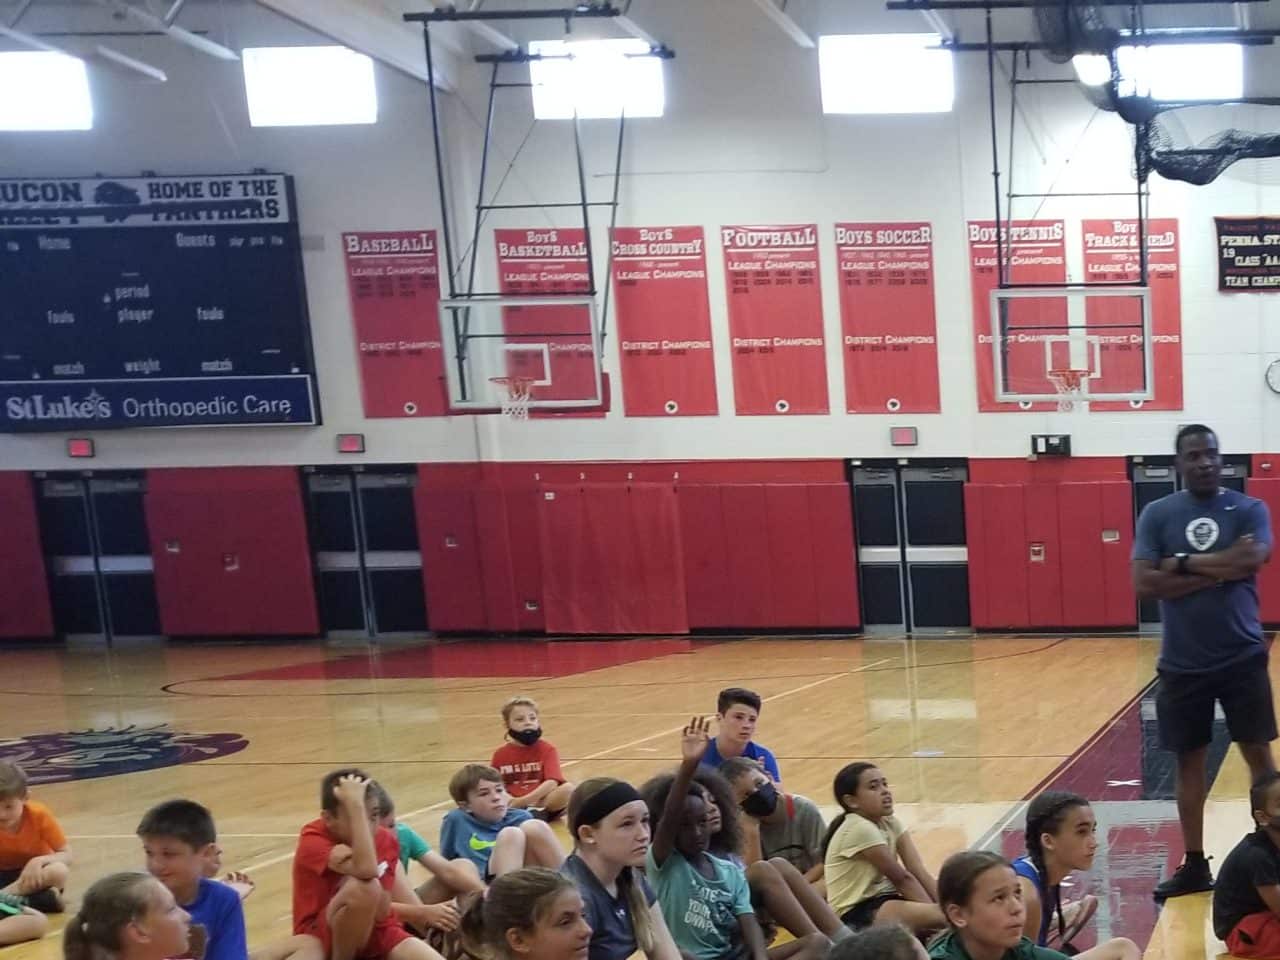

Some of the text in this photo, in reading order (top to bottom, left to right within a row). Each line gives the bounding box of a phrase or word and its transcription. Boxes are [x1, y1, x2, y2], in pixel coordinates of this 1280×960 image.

[147, 179, 279, 199] HOME OF THE
[1008, 223, 1063, 240] TENNIS
[1112, 221, 1140, 233] BOY
[527, 231, 558, 243] BOYS
[639, 229, 672, 241] BOYS
[722, 228, 816, 246] FOOTBALL
[836, 226, 932, 244] BOYS SOCCER
[1085, 233, 1128, 247] TRACK
[345, 234, 433, 253] BASEBALL
[498, 242, 588, 257] BASKETBALL
[611, 240, 702, 255] CROSS COUNTRY
[1222, 247, 1235, 258] 19
[764, 260, 817, 270] CHAMPIONS
[878, 261, 930, 270] CHAMPIONS
[1234, 256, 1261, 267] CLASS
[653, 270, 704, 279] CHAMPIONS
[1224, 276, 1249, 287] TEAM
[122, 396, 239, 417] Orthopedic
[242, 395, 292, 414] Care
